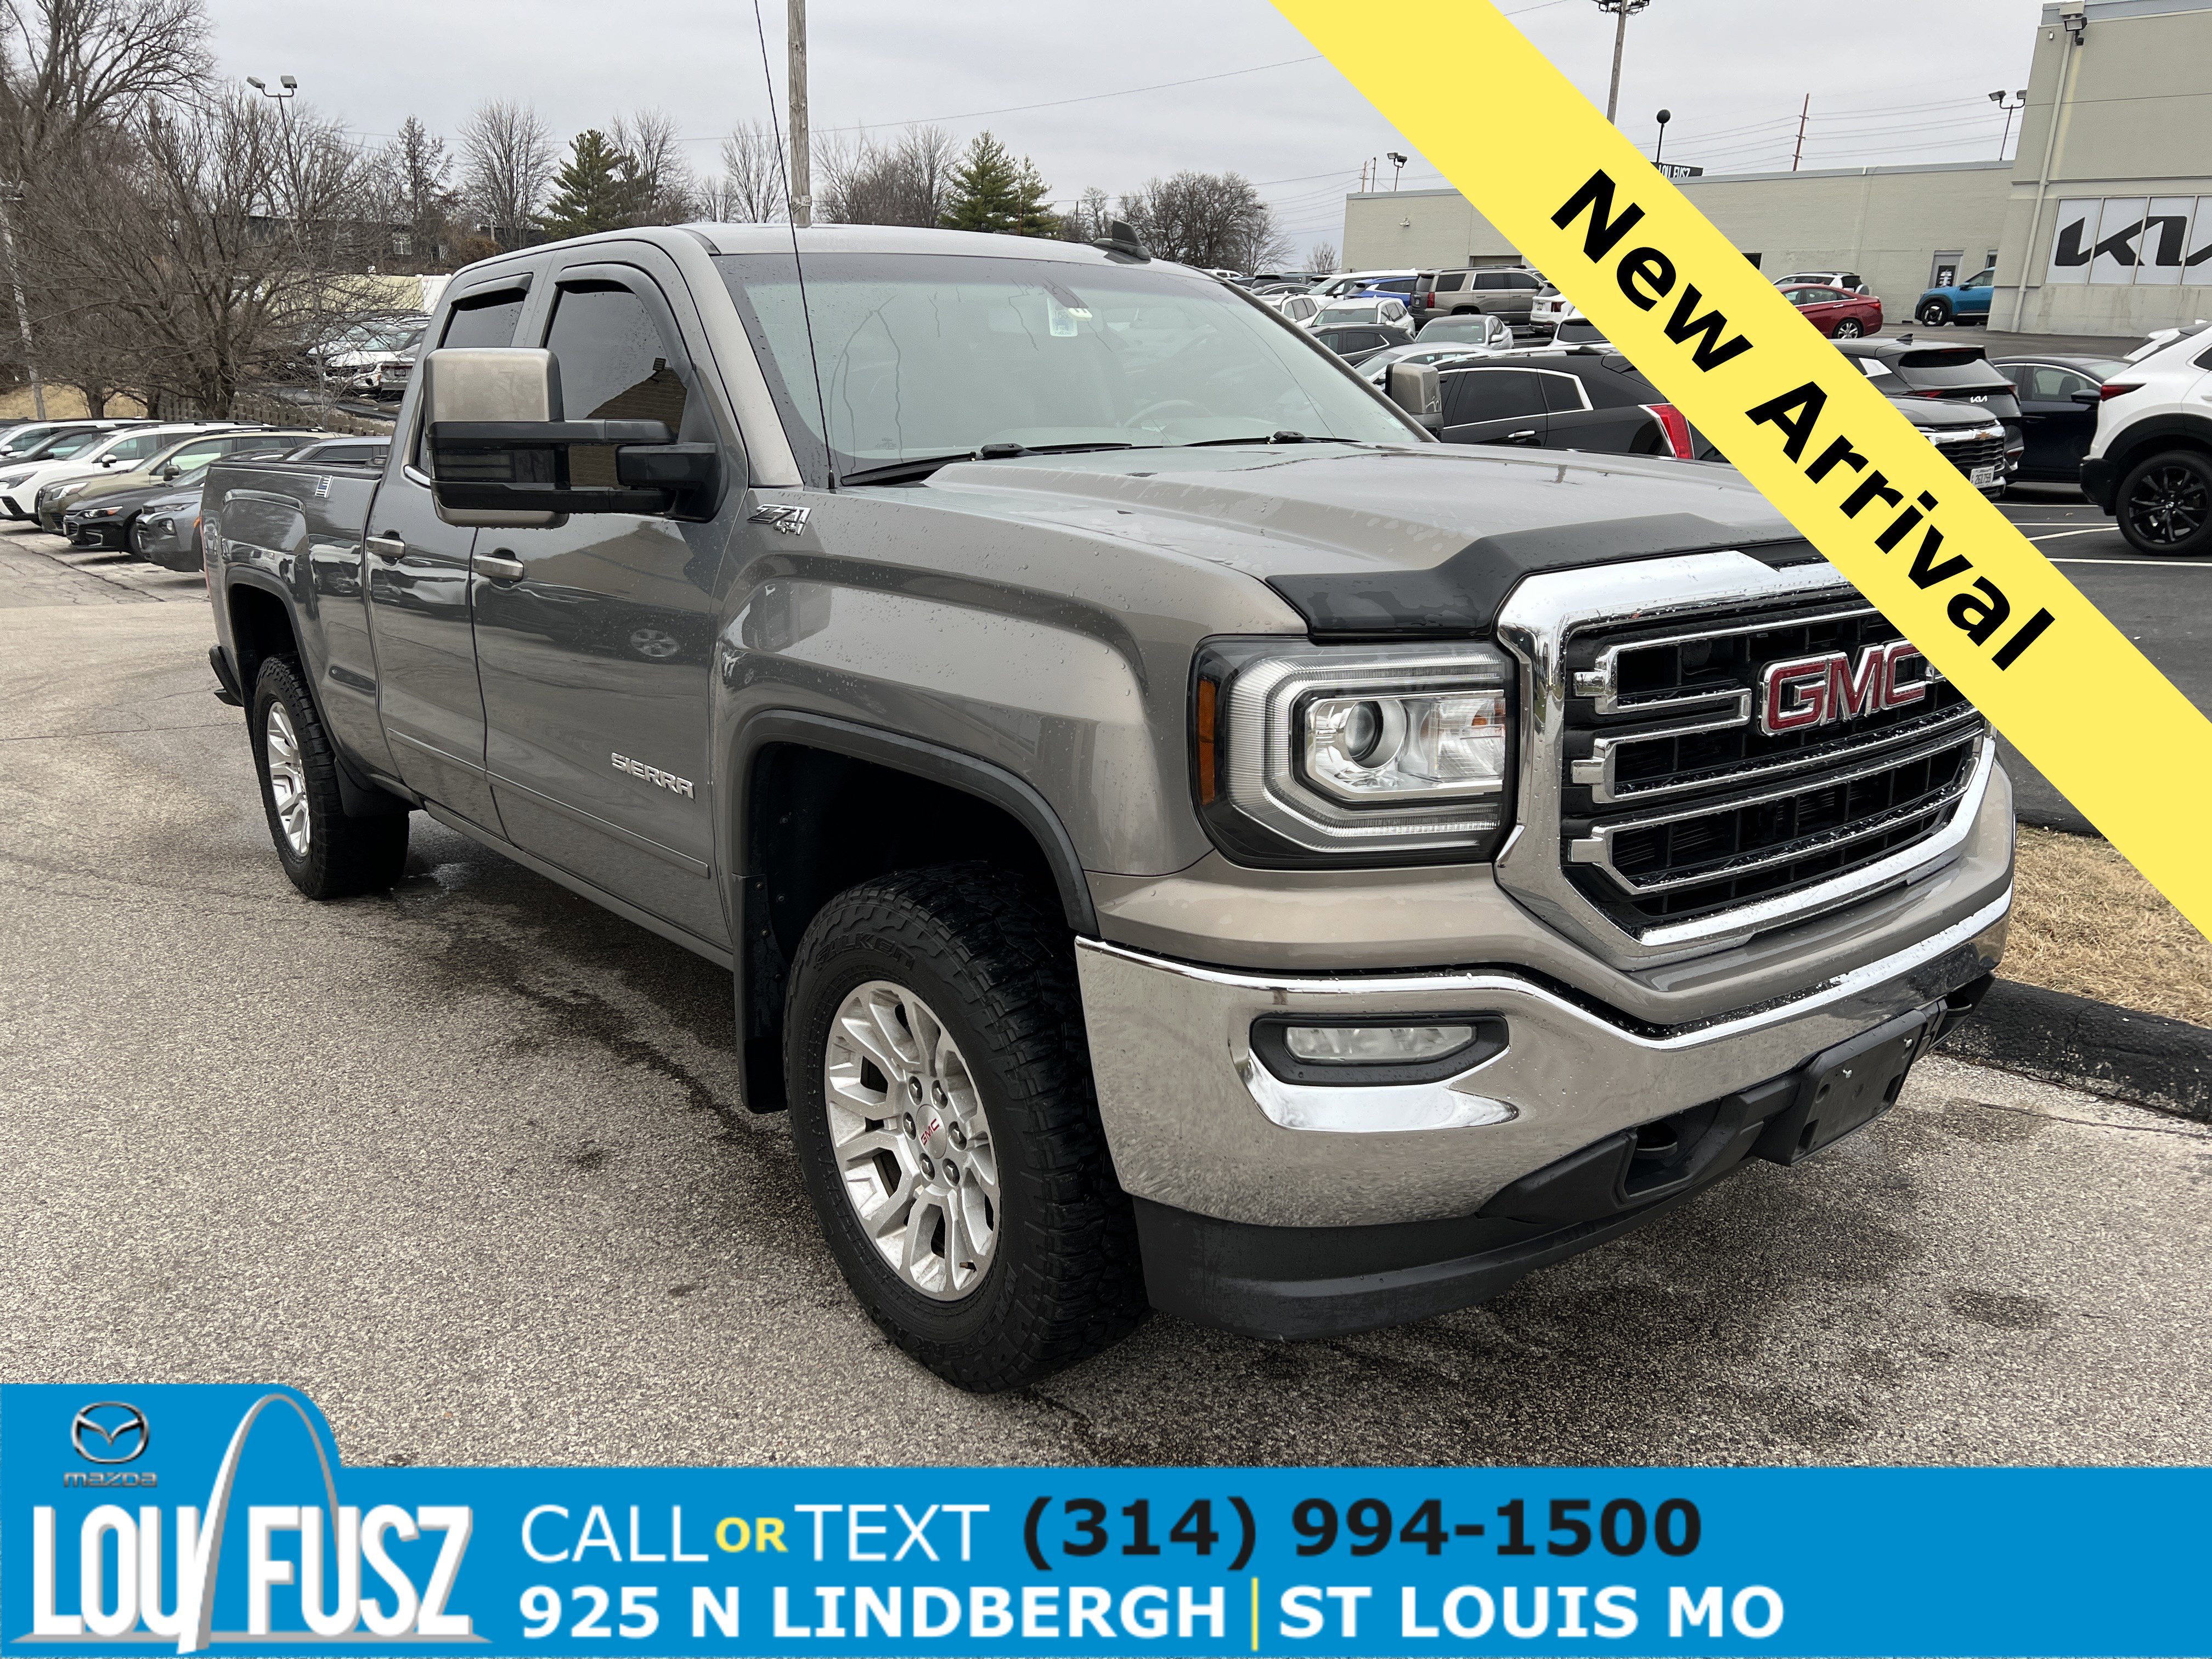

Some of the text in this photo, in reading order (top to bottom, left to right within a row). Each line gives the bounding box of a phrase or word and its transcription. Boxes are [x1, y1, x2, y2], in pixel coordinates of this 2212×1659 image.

[1970, 395, 1988, 403] KIA
[747, 503, 811, 524] Z71
[1757, 639, 1925, 737] GMC
[611, 752, 695, 800] SIERRA
[921, 1118, 940, 1146] GMC
